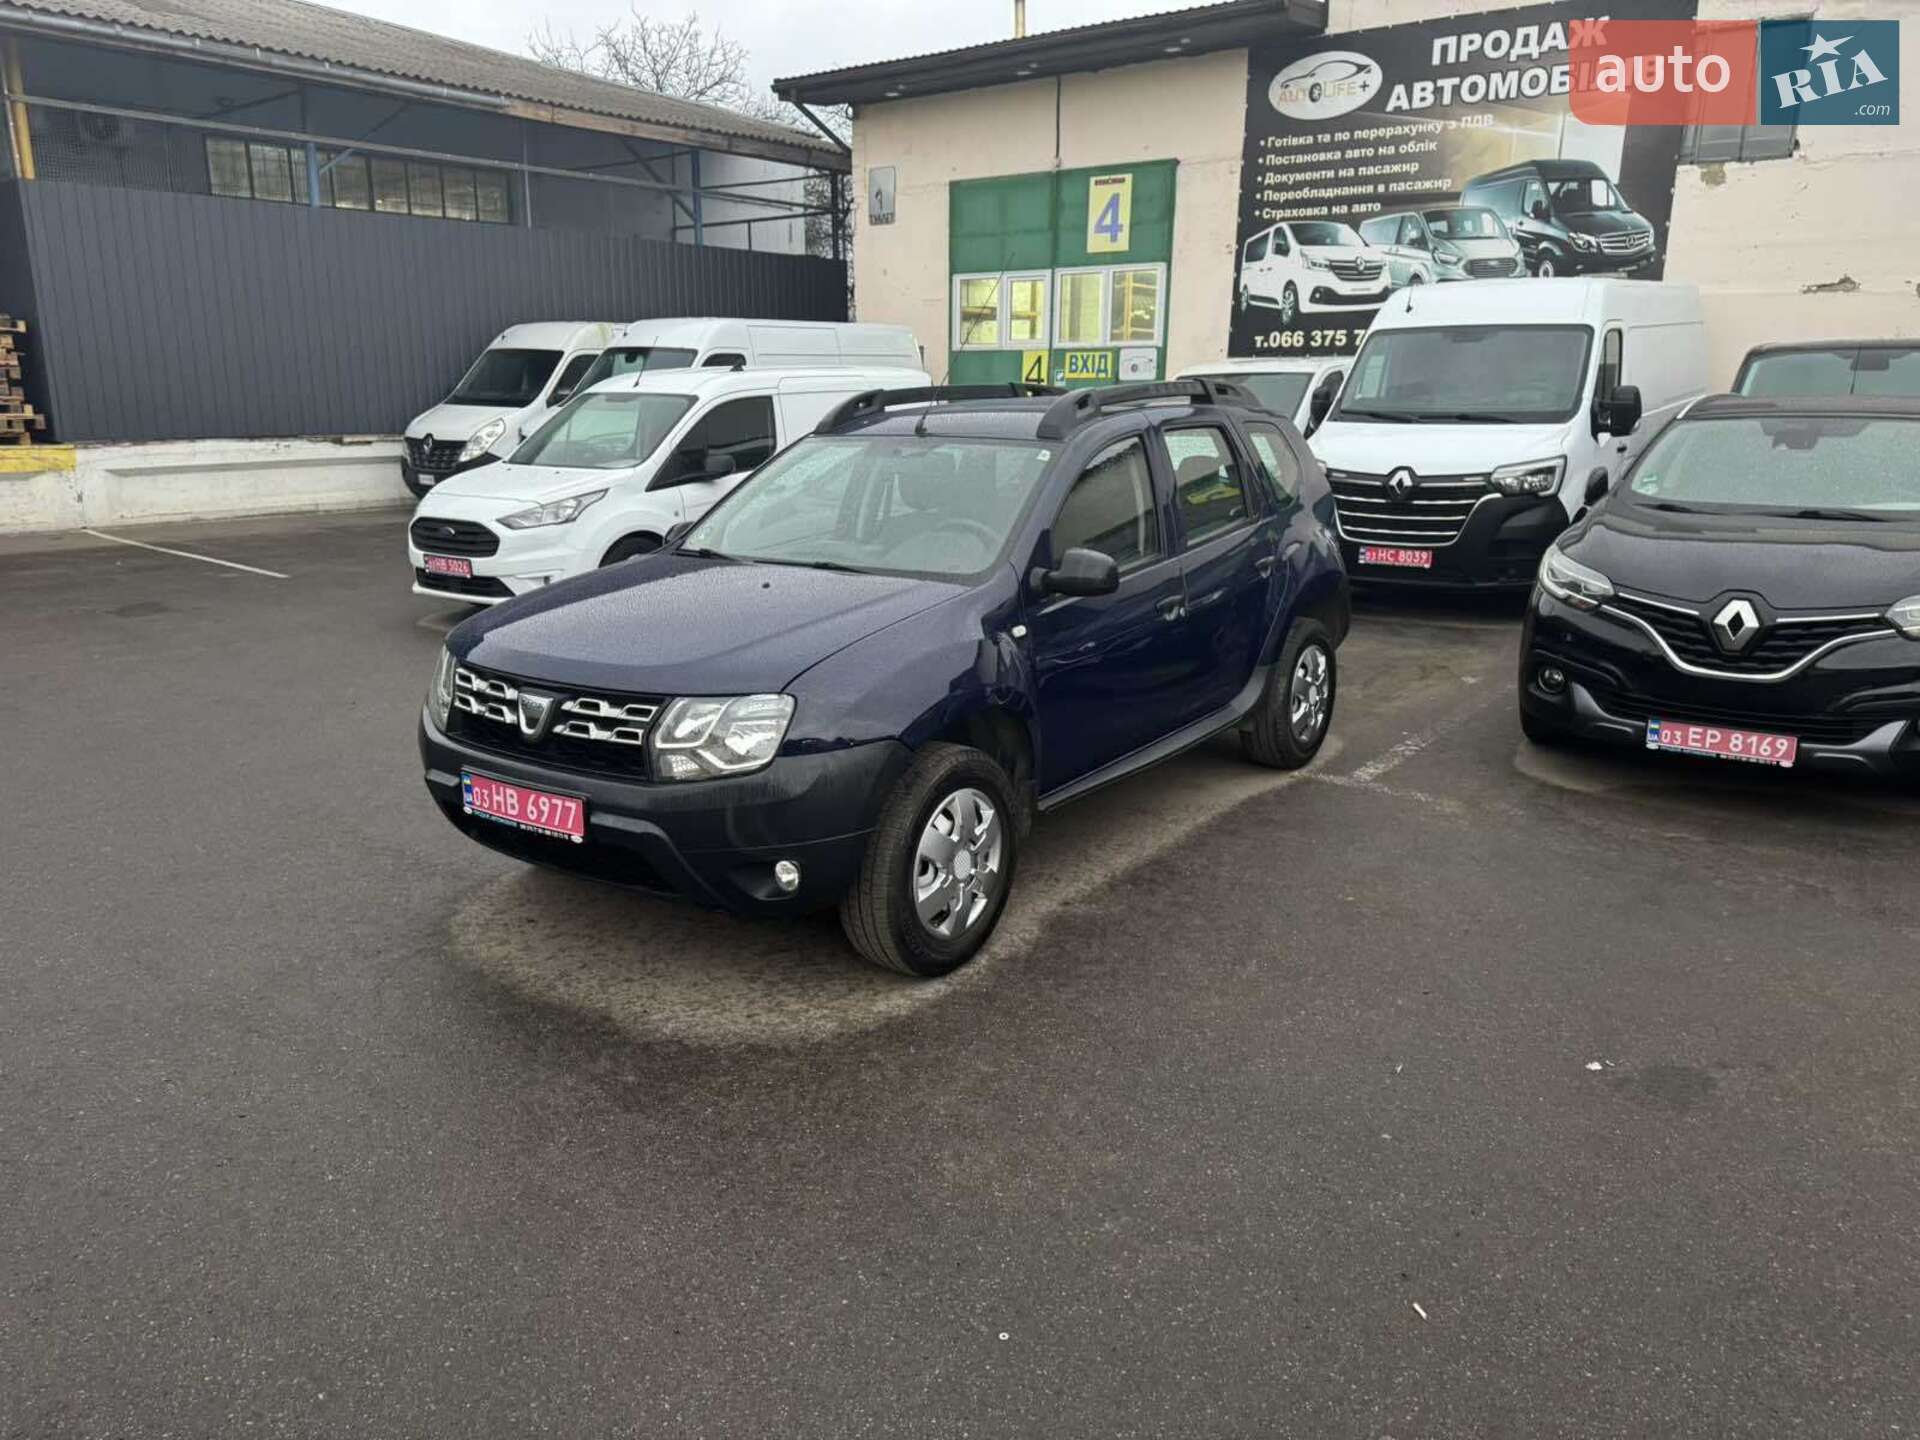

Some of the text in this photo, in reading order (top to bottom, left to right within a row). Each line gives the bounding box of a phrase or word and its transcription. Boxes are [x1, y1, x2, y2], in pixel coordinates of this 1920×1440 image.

[1431, 16, 1610, 66] ПРОДАЖ
[1267, 137, 1313, 148] Готівка
[1316, 134, 1331, 144] та
[1334, 132, 1350, 142] по
[1354, 121, 1444, 141] перерахунку
[1266, 140, 1438, 166] Постановка авто на облік
[1264, 161, 1419, 186] Документи на пасажир
[1389, 178, 1452, 194] пасажир
[1093, 192, 1124, 243] 4
[1262, 202, 1381, 219] Страховка на авто
[1254, 331, 1305, 348] т.066
[1310, 329, 1347, 347] 375
[1025, 354, 1045, 384] 4
[1069, 353, 1108, 376] ВХІД
[1398, 550, 1429, 563] 8039
[1661, 729, 1682, 745] 03
[1687, 727, 1721, 749] EP
[1729, 733, 1788, 757] 8169
[472, 787, 489, 809] 03
[492, 784, 519, 816] HB
[526, 793, 577, 829] 6977
